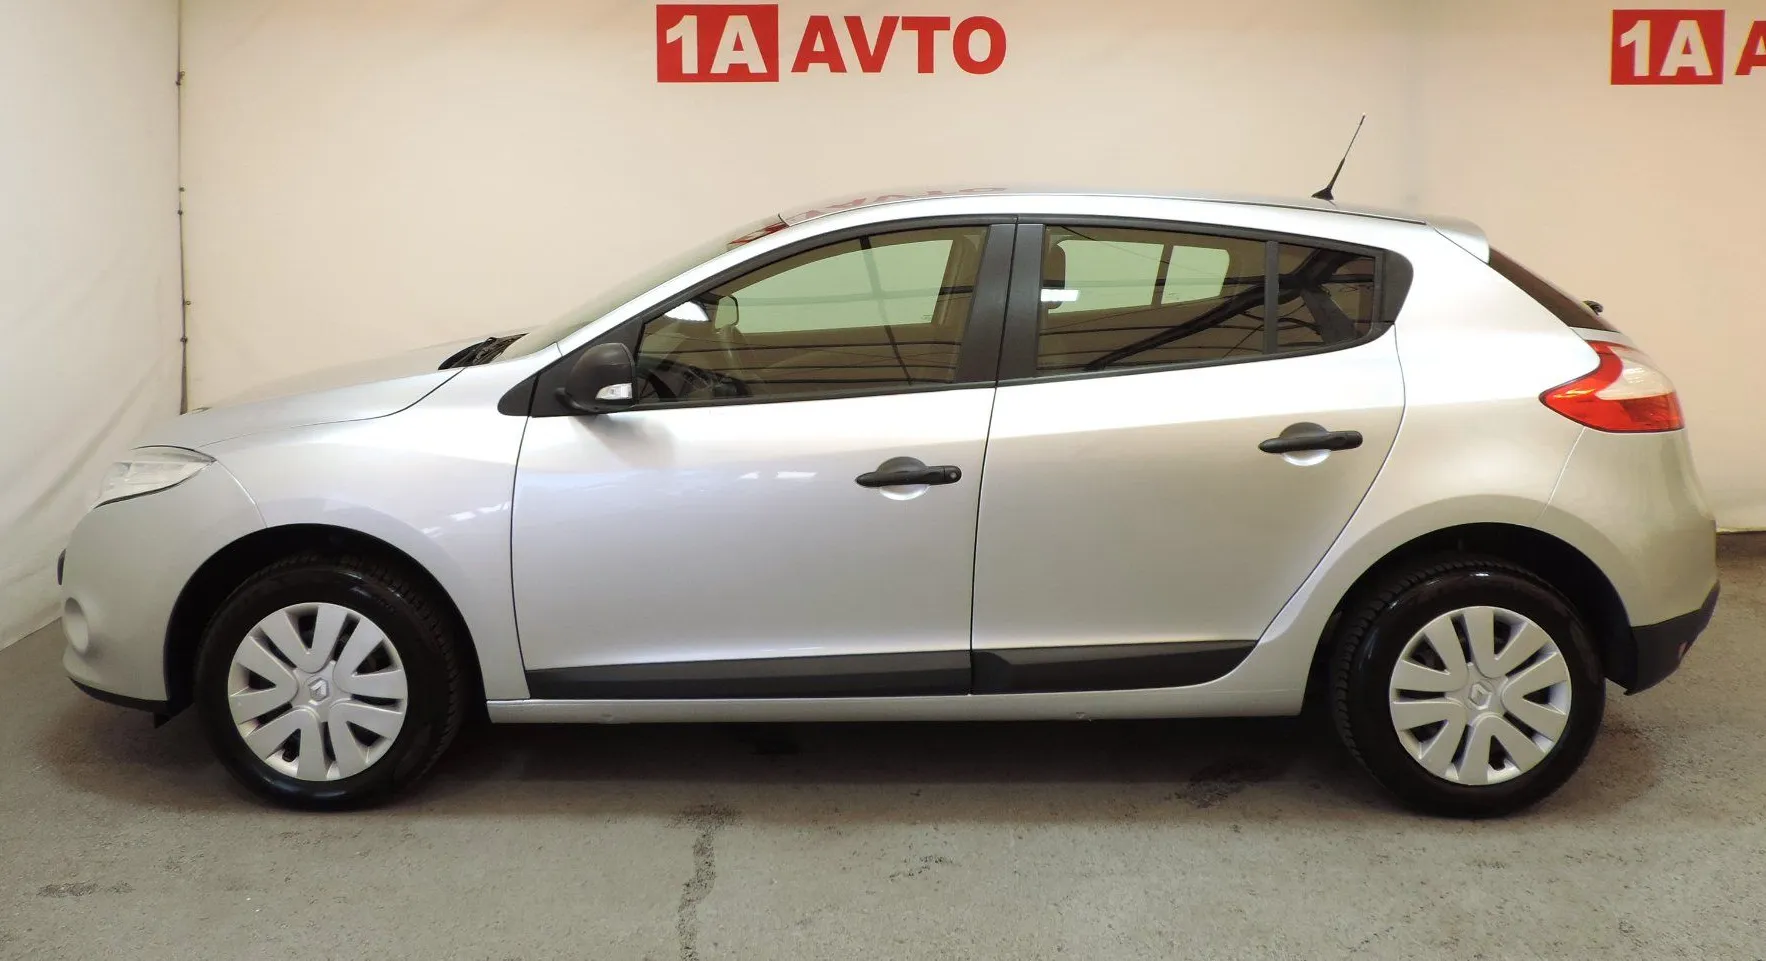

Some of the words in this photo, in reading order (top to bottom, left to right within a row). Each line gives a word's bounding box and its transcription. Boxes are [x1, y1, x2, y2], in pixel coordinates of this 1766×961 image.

[665, 14, 768, 74] 1A
[790, 15, 1007, 75] AVTO
[1620, 19, 1714, 77] 1A
